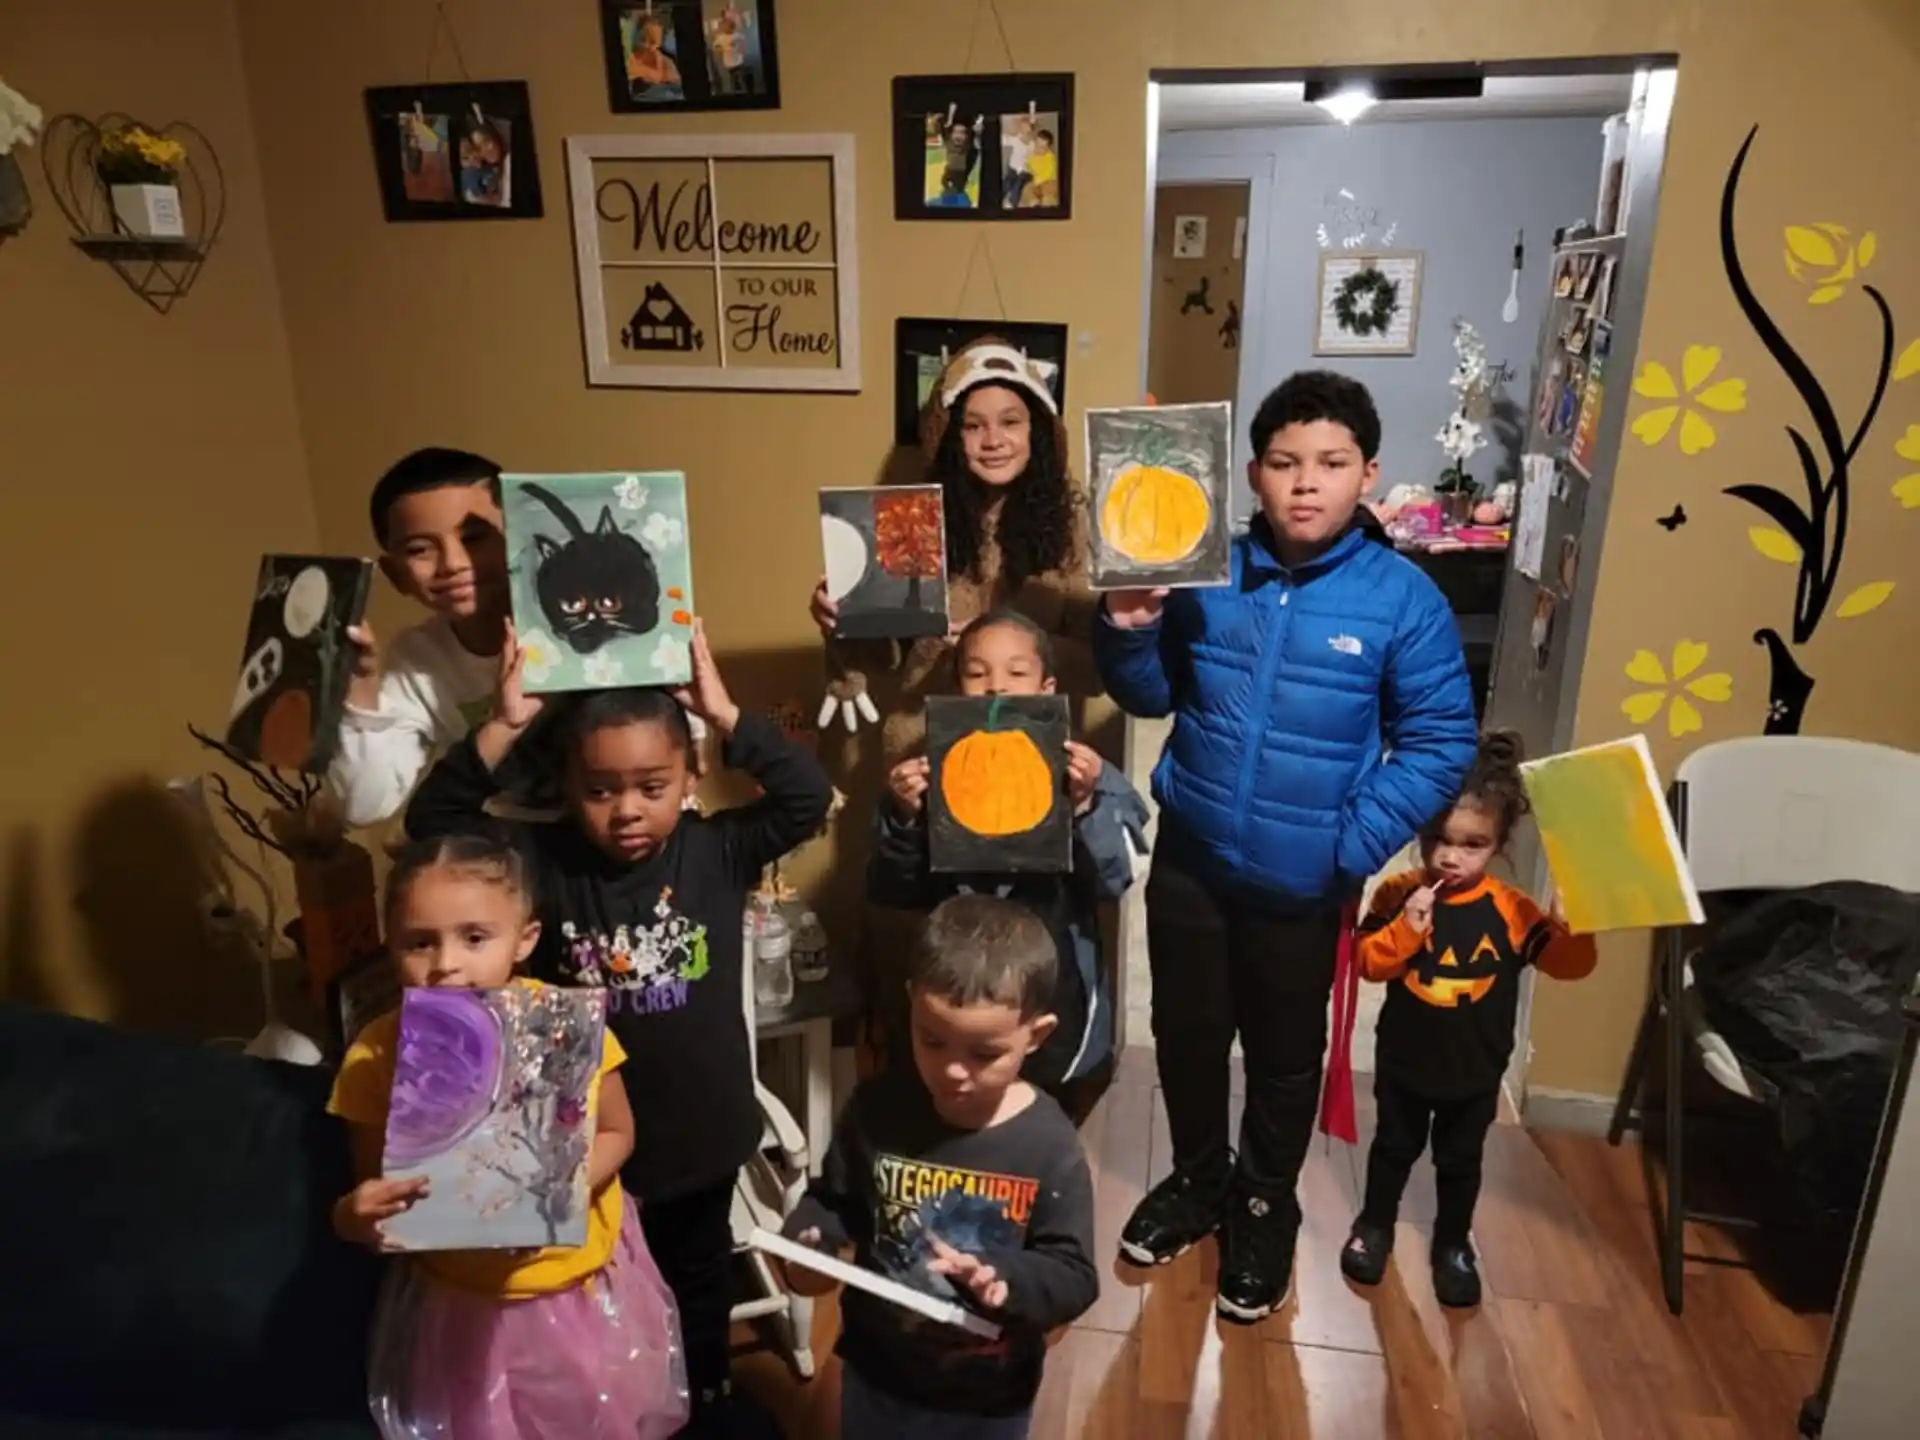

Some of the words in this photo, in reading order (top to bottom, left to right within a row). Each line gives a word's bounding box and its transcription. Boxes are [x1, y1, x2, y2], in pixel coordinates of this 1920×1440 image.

[596, 178, 820, 254] Welcome
[736, 277, 765, 296] TO
[770, 277, 818, 297] OUR
[726, 303, 835, 355] Home
[630, 980, 688, 1014] CREW
